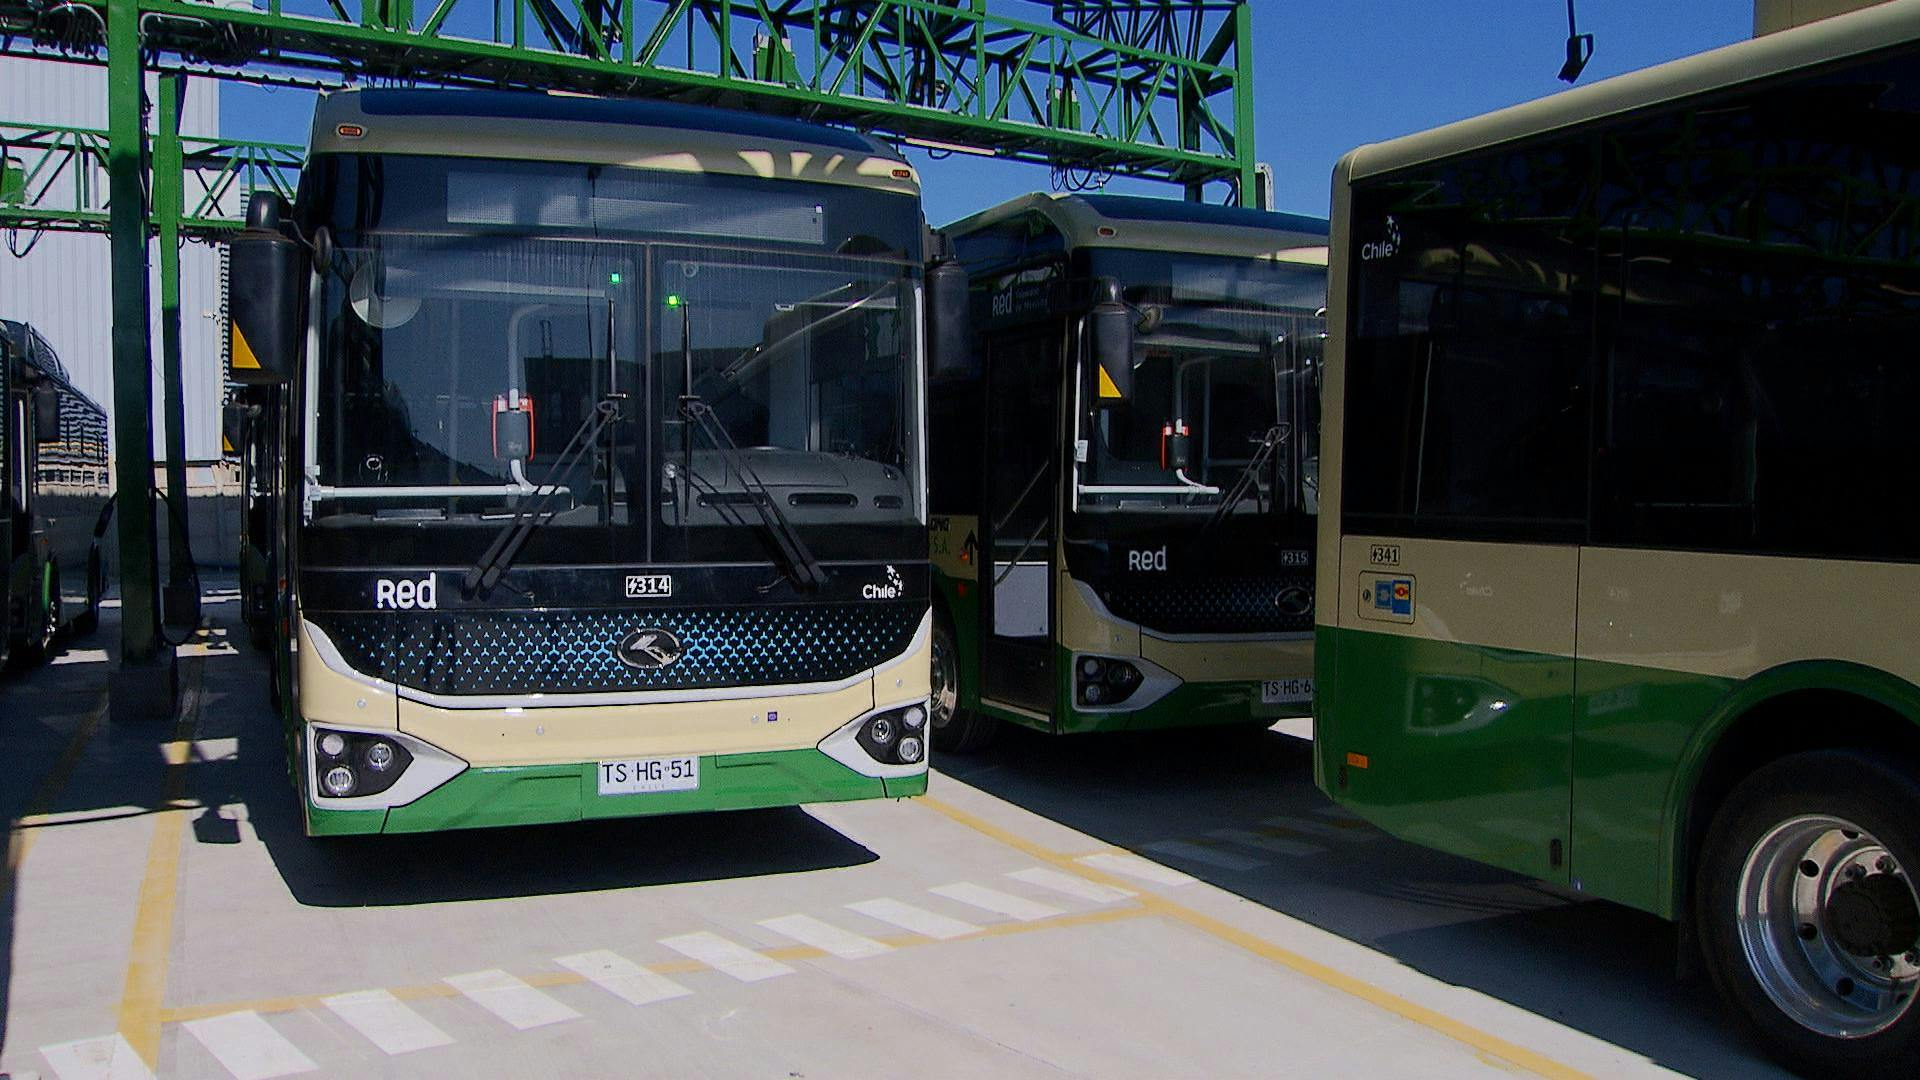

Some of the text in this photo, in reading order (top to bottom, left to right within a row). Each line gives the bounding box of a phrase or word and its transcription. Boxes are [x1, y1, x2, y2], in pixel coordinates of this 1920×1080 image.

[1361, 240, 1394, 261] Chile
[992, 285, 1013, 318] Red
[1128, 544, 1167, 572] Red
[1287, 551, 1308, 565] 315
[1376, 547, 1398, 563] 341
[376, 571, 438, 610] Red
[636, 577, 669, 594] 314
[862, 583, 897, 600] Chile
